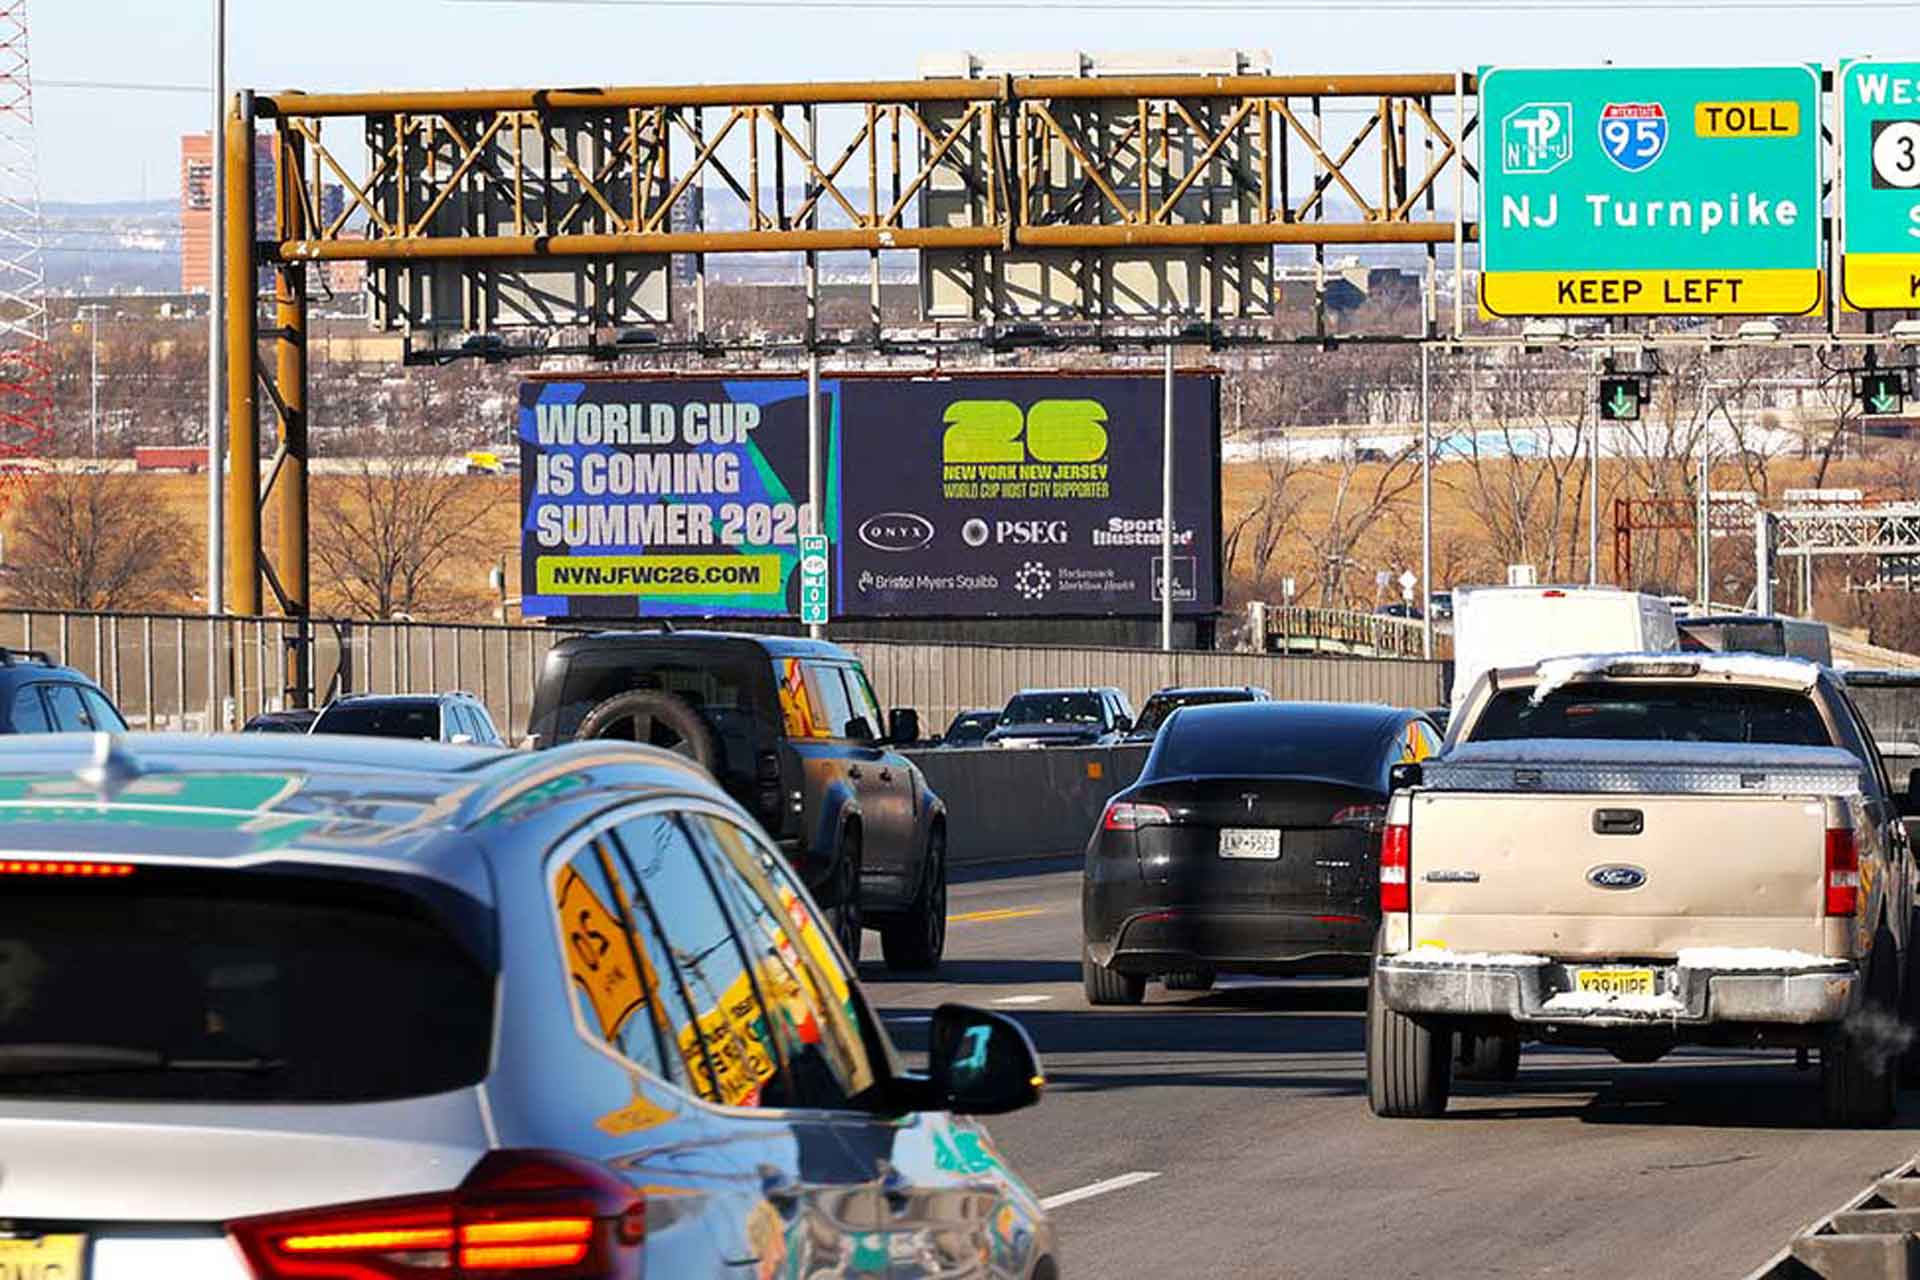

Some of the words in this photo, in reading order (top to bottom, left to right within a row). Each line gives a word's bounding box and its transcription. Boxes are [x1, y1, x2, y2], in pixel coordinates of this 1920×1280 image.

[1856, 73, 1920, 104] WE
[1708, 107, 1789, 132] TOLL
[1604, 121, 1661, 157] 95
[1896, 136, 1915, 172] 3
[1502, 195, 1558, 229] NJ
[1586, 192, 1799, 234] Turnpike
[1558, 280, 1642, 304] KEEP
[1664, 279, 1743, 303] LEFT
[536, 403, 675, 444] WORLD
[683, 403, 761, 444] CUP
[943, 400, 1108, 462] 26
[536, 453, 574, 496] IS
[581, 453, 740, 495] COMING
[943, 464, 976, 480] NEW
[978, 464, 1016, 480] YORK
[1019, 464, 1052, 480] NEW
[1053, 464, 1108, 480] JERSEY
[536, 503, 713, 546] SUMMER
[871, 526, 921, 537] ONYX
[996, 520, 1068, 544] PSEG
[875, 574, 914, 589] Bristol
[916, 575, 954, 592] Myers
[956, 574, 999, 591] Squibb
